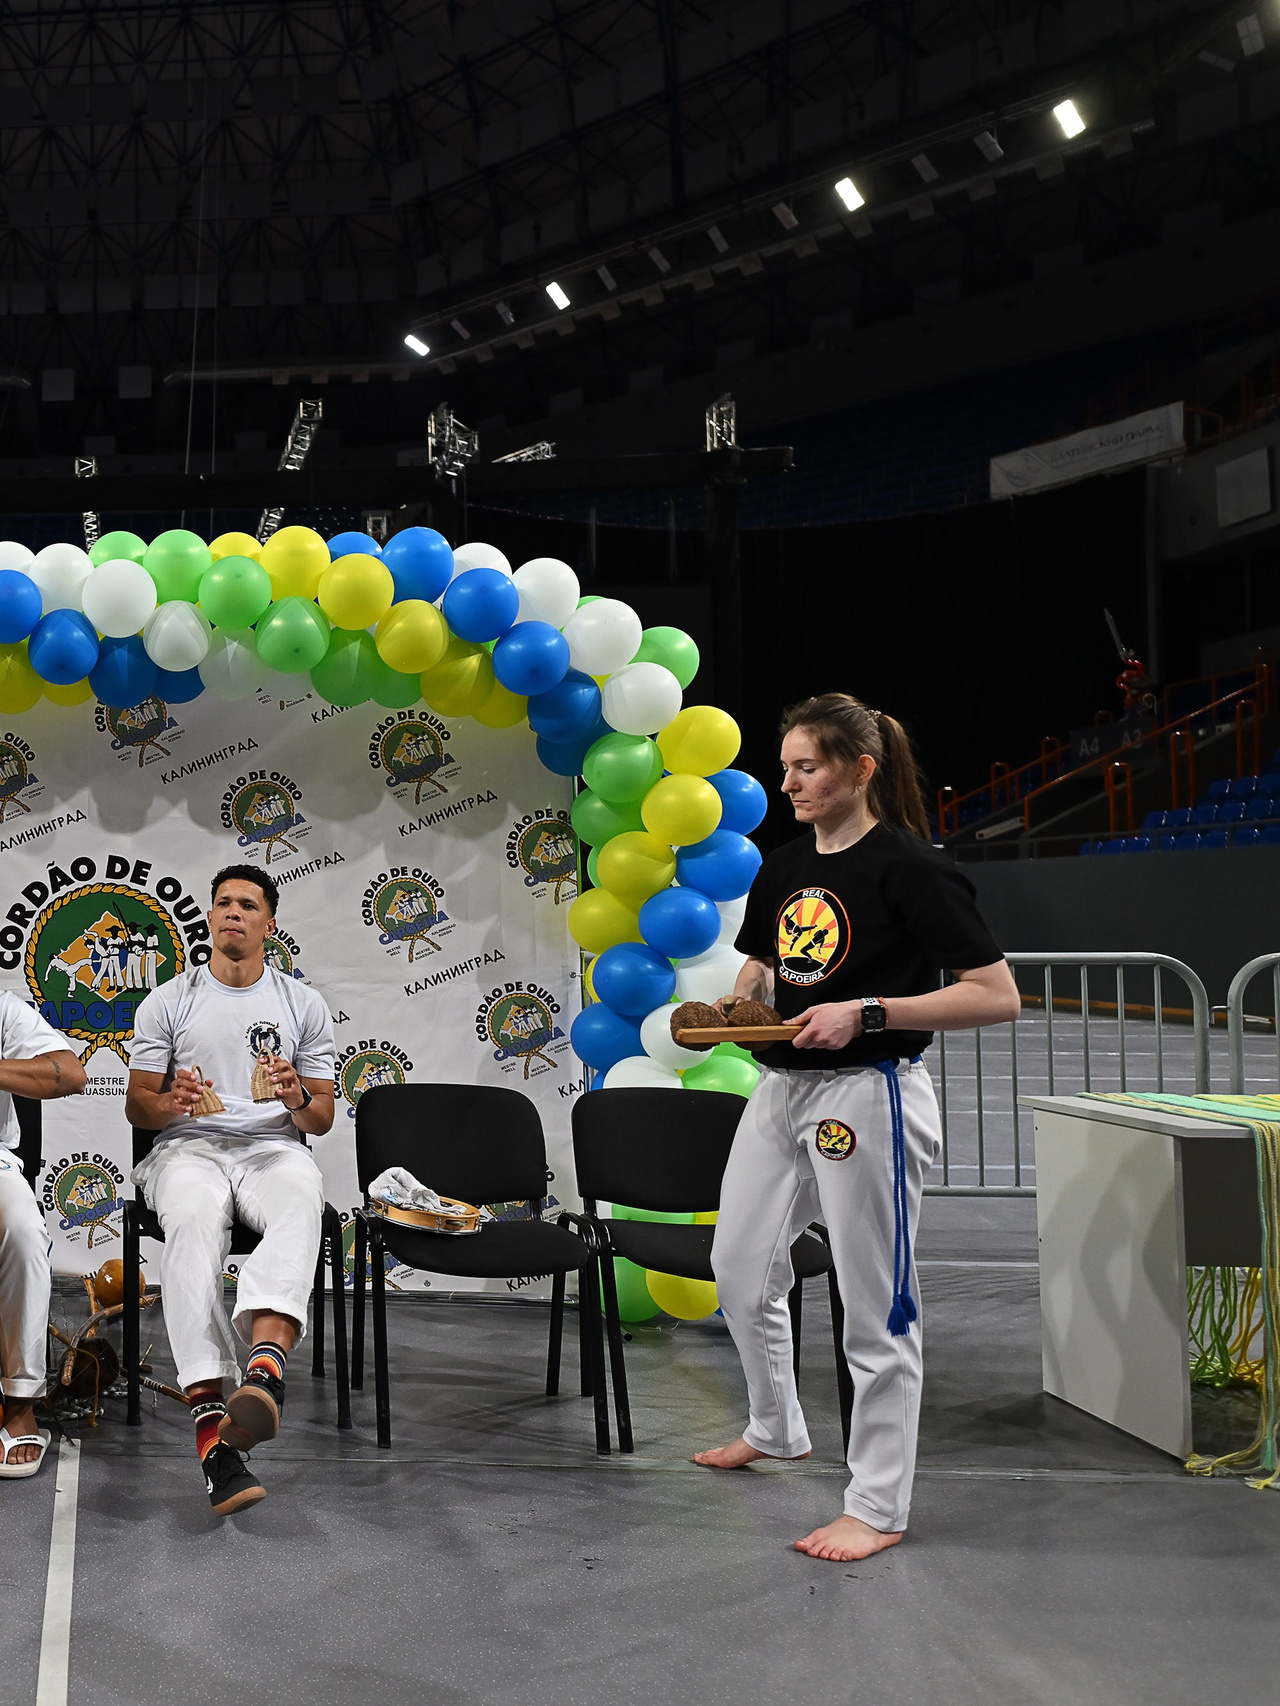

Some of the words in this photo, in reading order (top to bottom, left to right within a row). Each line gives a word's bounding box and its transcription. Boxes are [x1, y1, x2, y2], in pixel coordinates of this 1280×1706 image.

[95, 700, 106, 732] COR
[4, 732, 35, 761] OURO
[369, 717, 395, 769] CORDÃO
[397, 710, 415, 721] DE
[418, 712, 451, 741] OURO
[1079, 737, 1100, 757] A4
[160, 738, 258, 784] КАЛИНИНГРАД
[221, 777, 246, 828] CORDÃO
[249, 770, 266, 781] DE
[270, 772, 302, 801] OURO
[398, 790, 498, 837] КАЛИНИНГРАД
[237, 813, 306, 847] CAPOEIRA
[506, 815, 533, 868] CORDÃO
[534, 809, 553, 819] DE
[273, 851, 345, 887] ИНИНГРАД
[105, 854, 152, 886] DE
[156, 876, 212, 968] OURO
[362, 873, 388, 926] CORDÃO
[390, 866, 408, 878] DE
[412, 868, 445, 898] OURO
[802, 890, 824, 899] REAL
[379, 910, 449, 945] CAPOEIRA
[404, 949, 505, 996] КАЛИНИНГРАД
[779, 966, 824, 983] CAPOEIRA
[476, 988, 503, 1042] CORDÃO
[504, 982, 523, 993] DE
[527, 983, 561, 1014] OURO
[358, 1039, 376, 1050] DE
[380, 1041, 413, 1072] OURO
[493, 1026, 565, 1062] CAPOEIRA
[86, 1077, 125, 1086] MESTRE
[43, 1158, 70, 1212] CORDÃO
[71, 1152, 89, 1164] DE
[93, 1154, 125, 1185] OURO
[59, 1197, 125, 1231] CAPOEIRA
